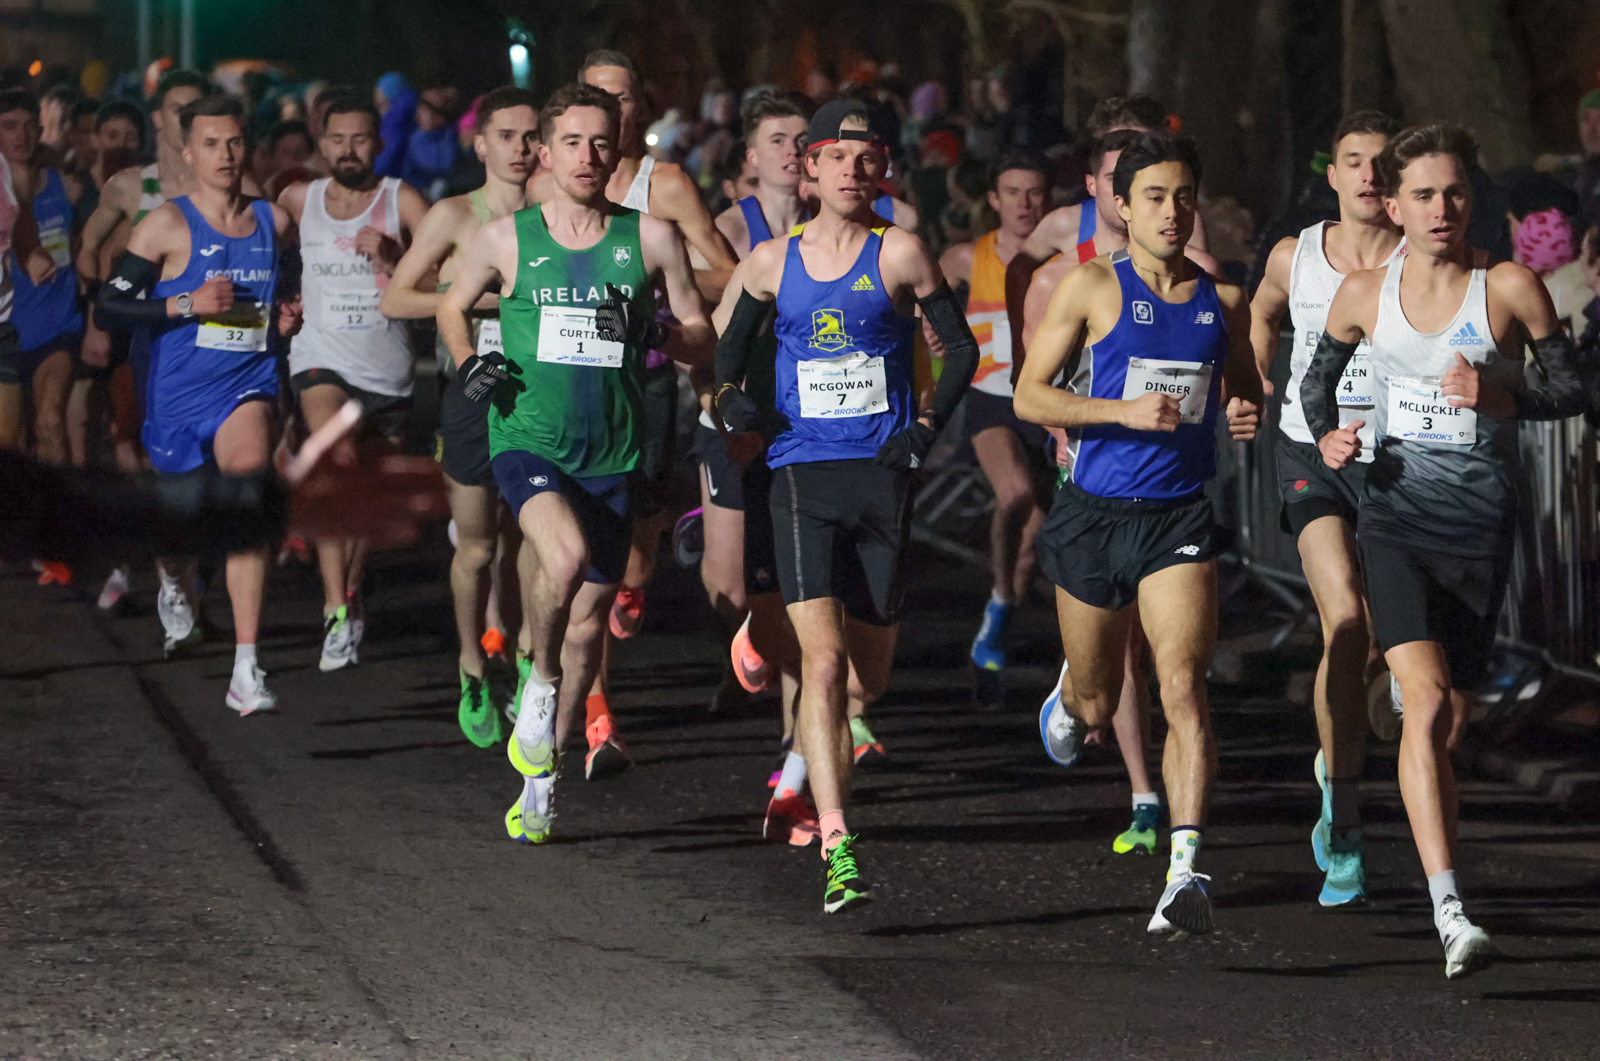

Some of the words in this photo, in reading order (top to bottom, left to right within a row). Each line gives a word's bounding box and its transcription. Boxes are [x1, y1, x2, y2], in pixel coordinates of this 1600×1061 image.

[330, 304, 379, 312] CLEMENTS
[347, 314, 363, 324] 12
[226, 330, 244, 341] 32
[818, 334, 843, 342] B.A.A.
[484, 338, 503, 346] MA
[1449, 337, 1484, 346] adidas
[576, 341, 584, 354] 1
[570, 355, 602, 364] BROOKS
[1341, 368, 1367, 377] LEN
[809, 379, 873, 391] MCGOWAN
[1145, 381, 1191, 395] DINGER
[1343, 380, 1354, 393] 4
[837, 393, 847, 406] 7
[1339, 395, 1372, 403] BROOKS
[833, 406, 867, 415] BROOKS
[1399, 400, 1461, 416] MCLUCKIE
[1422, 417, 1433, 430] 3
[1417, 432, 1453, 441] BROOKS
